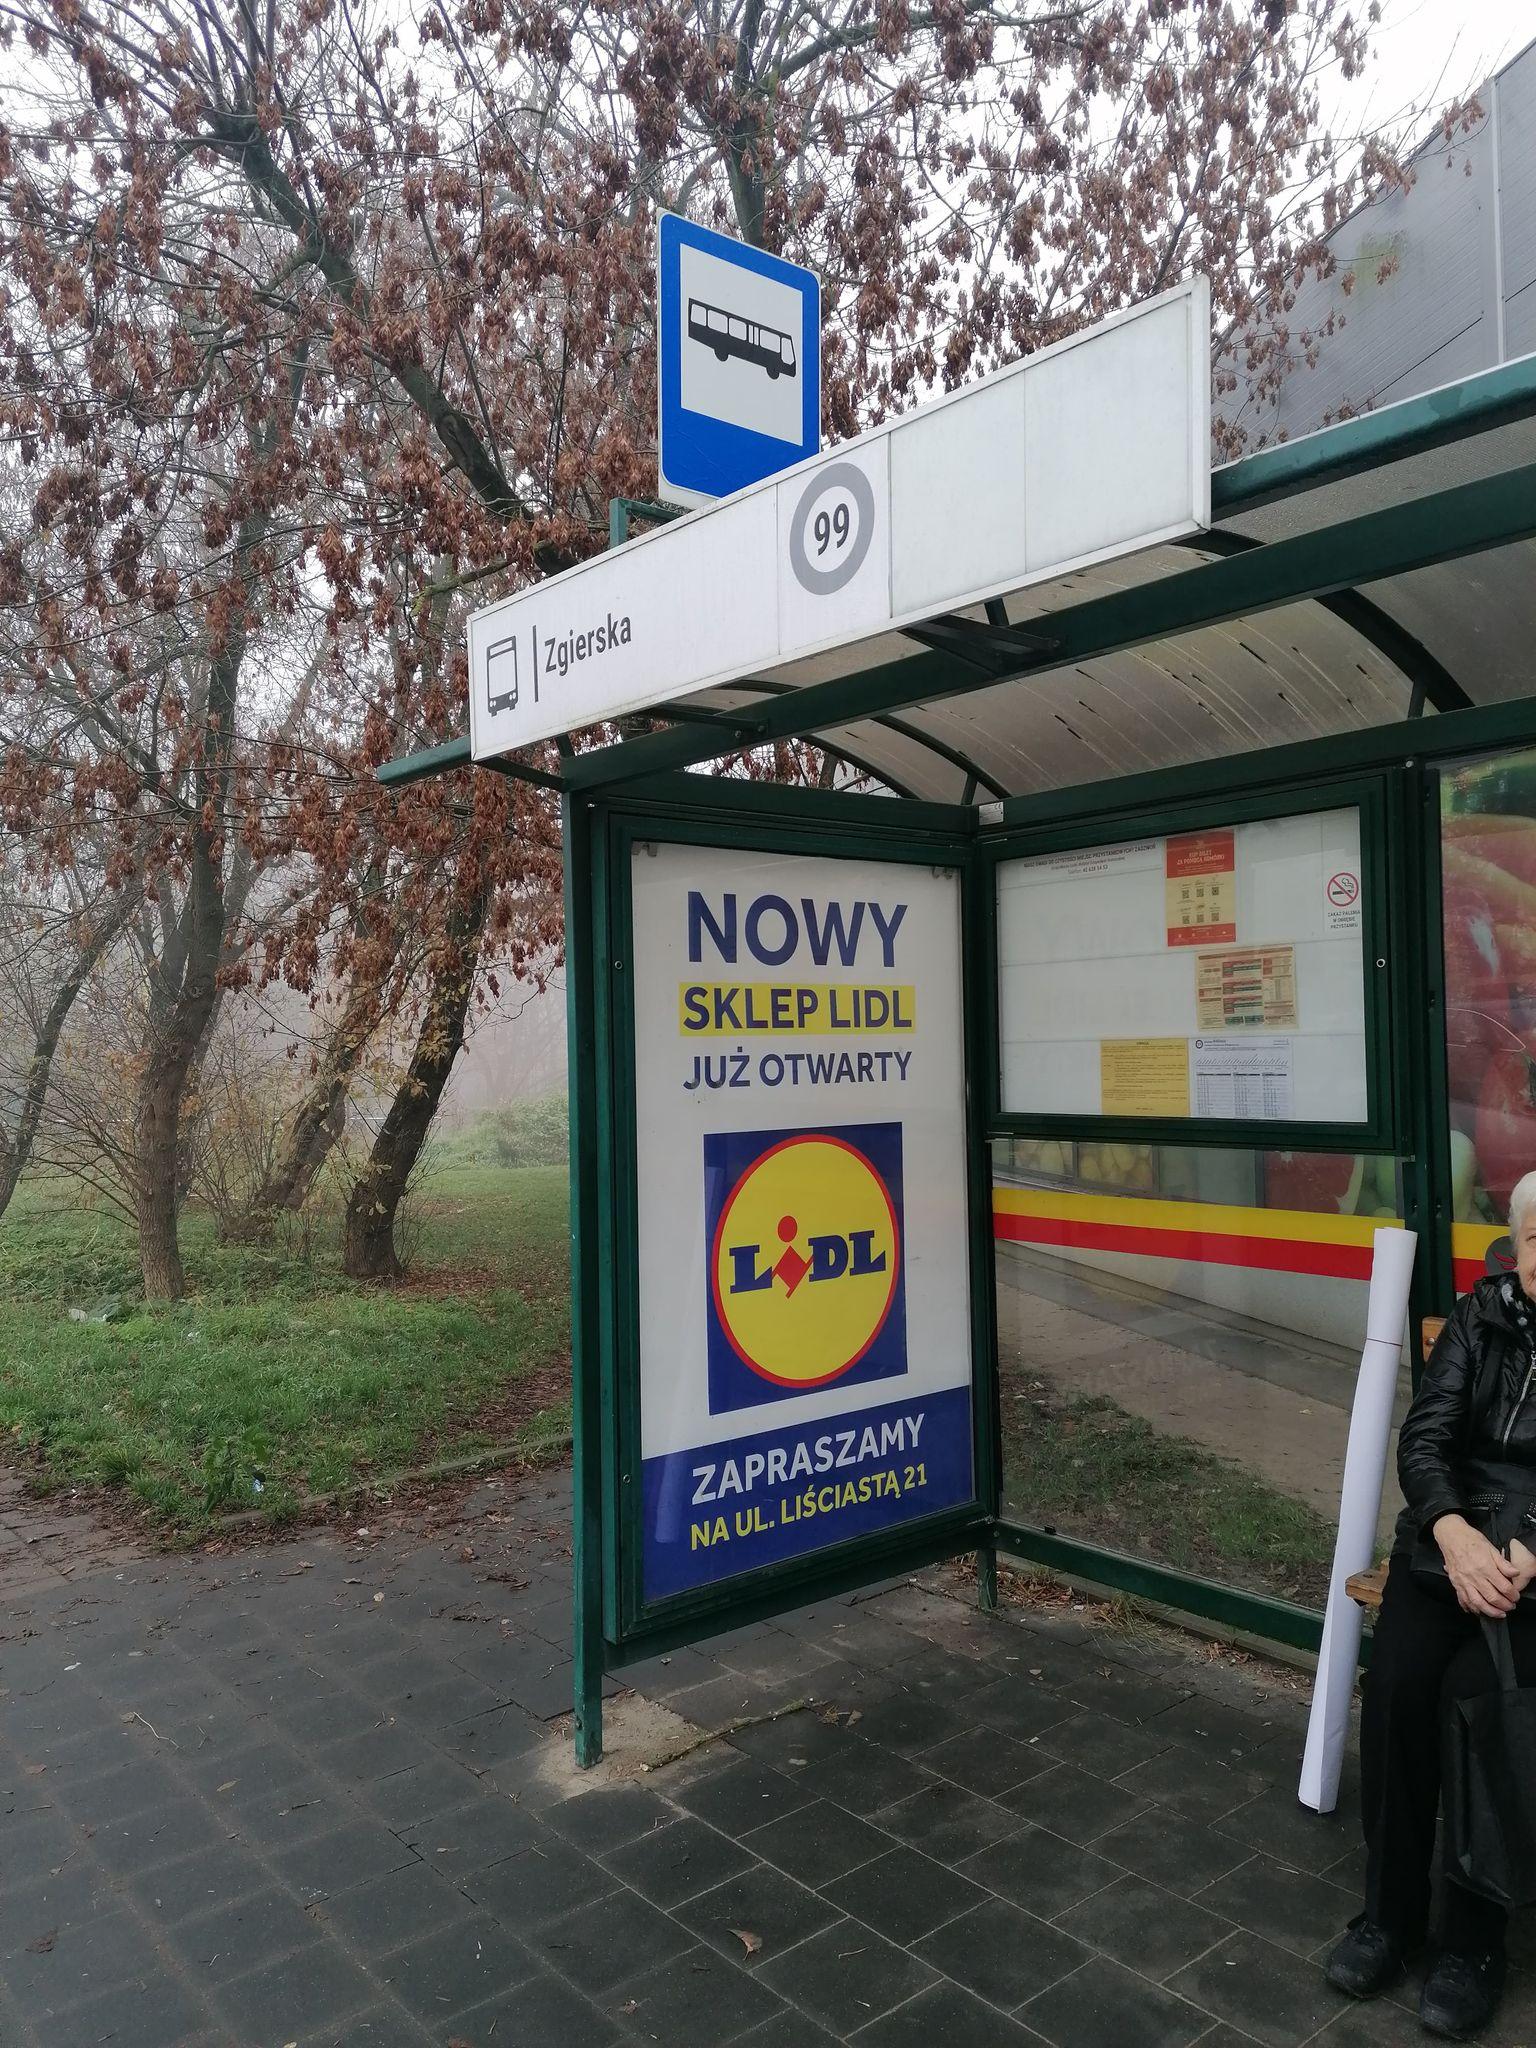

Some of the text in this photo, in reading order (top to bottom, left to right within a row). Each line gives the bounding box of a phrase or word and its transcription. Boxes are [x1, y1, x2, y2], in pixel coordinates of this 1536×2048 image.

[814, 503, 850, 556] 99
[544, 613, 632, 677] Zgierska
[687, 891, 908, 968] NOWY
[683, 986, 912, 1031] SKLEP LIDL
[683, 1046, 913, 1090] JUŻ OTWARTY
[691, 1412, 925, 1506] ZAPRASZAMY
[691, 1463, 928, 1551] NA UL. LIŚCIASTĄ 21
